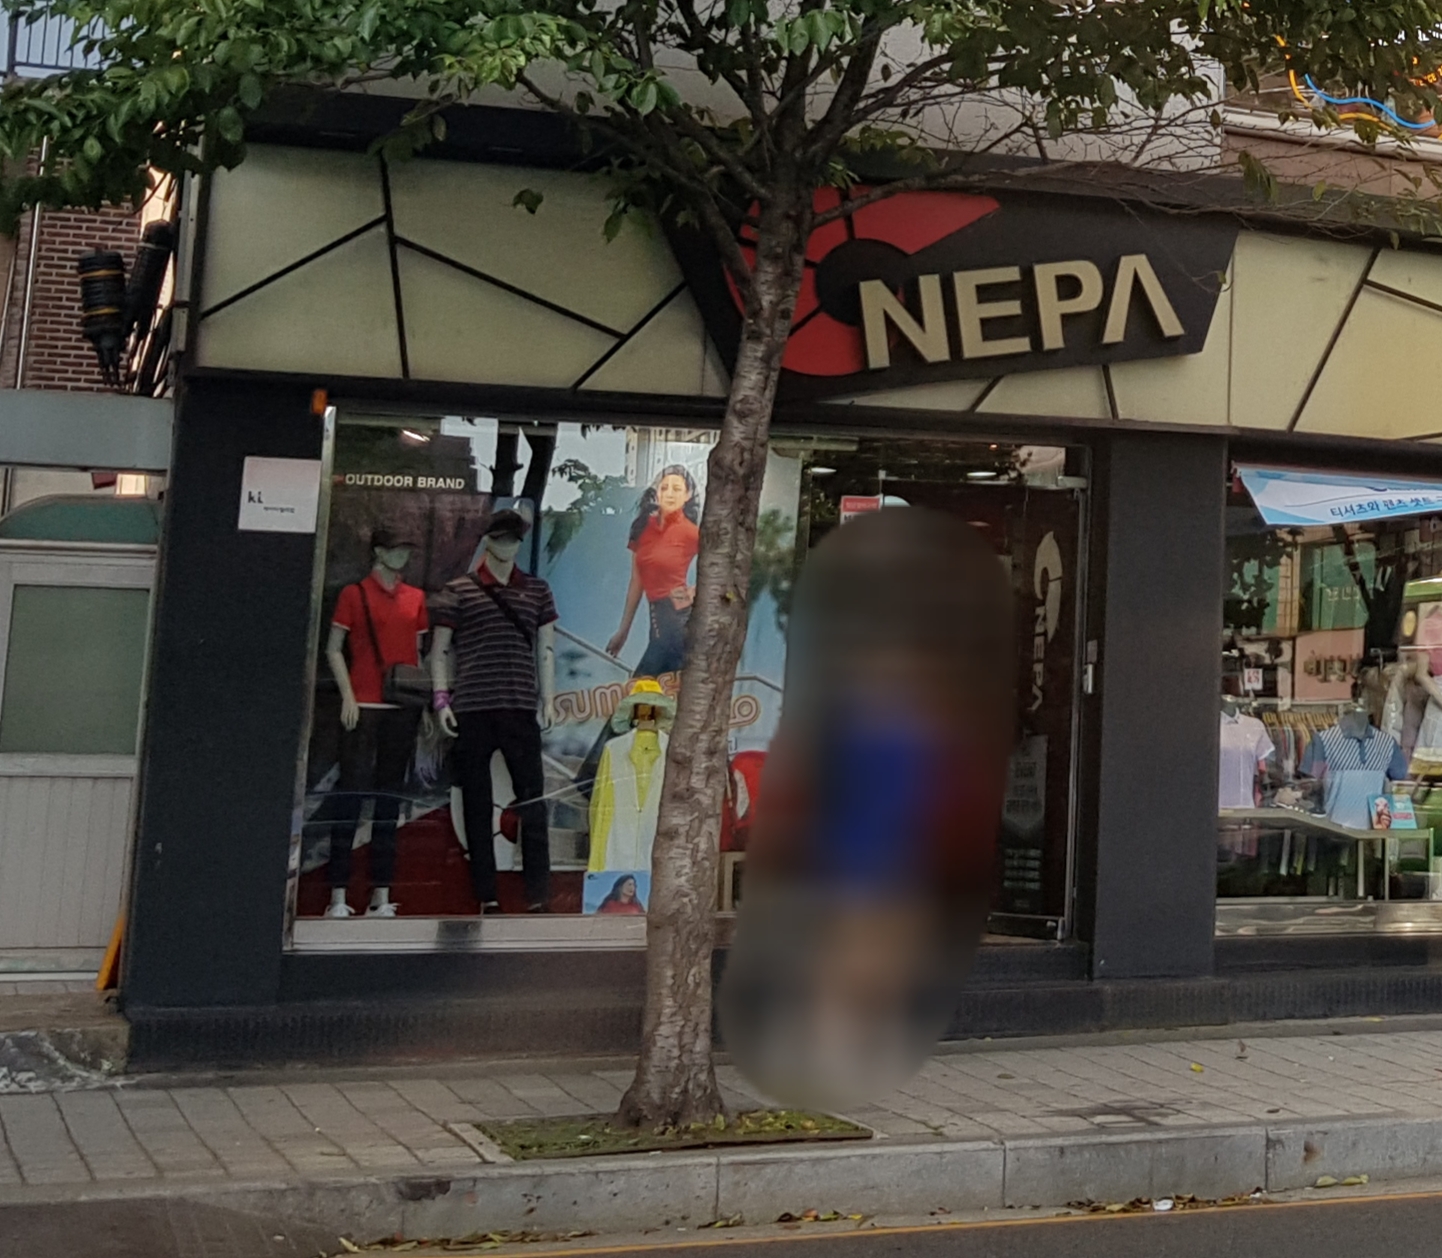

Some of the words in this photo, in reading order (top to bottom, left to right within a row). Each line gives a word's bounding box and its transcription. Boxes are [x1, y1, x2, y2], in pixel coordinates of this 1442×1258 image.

[859, 253, 1184, 370] NEPA
[345, 473, 414, 488] OUTDOOR
[417, 476, 466, 490] BRAND
